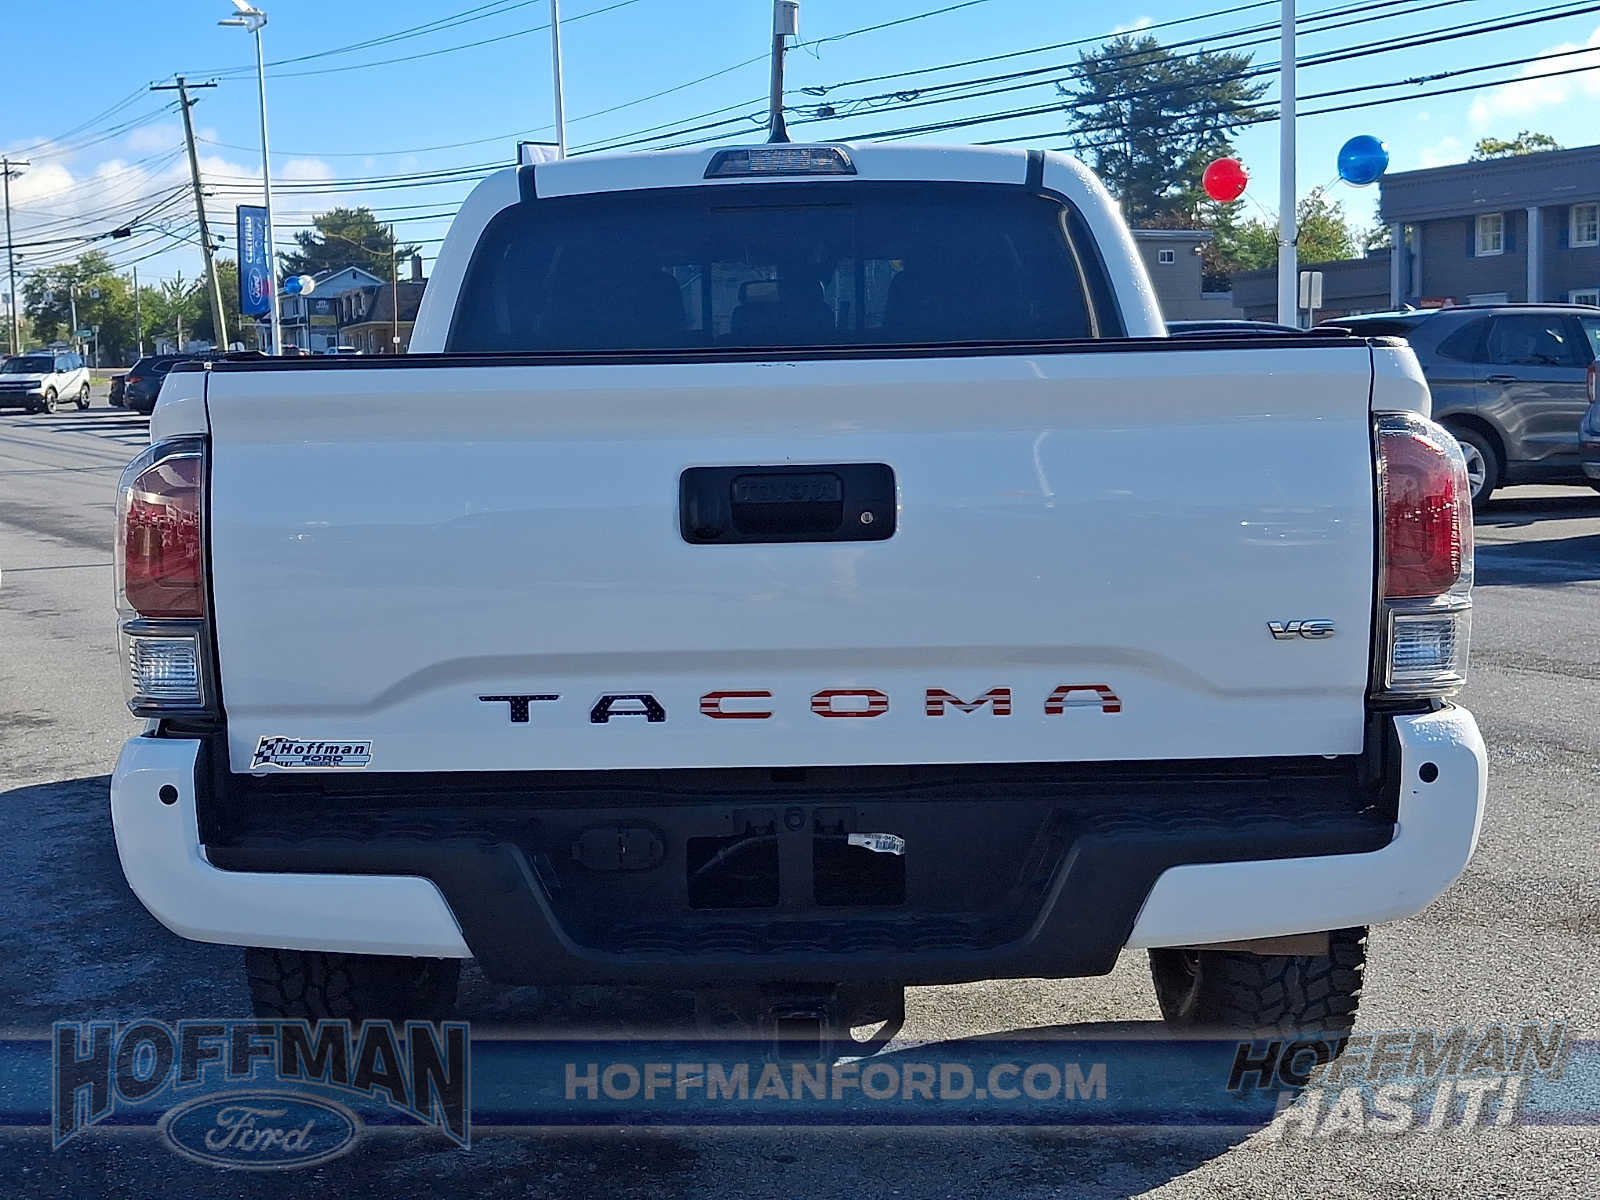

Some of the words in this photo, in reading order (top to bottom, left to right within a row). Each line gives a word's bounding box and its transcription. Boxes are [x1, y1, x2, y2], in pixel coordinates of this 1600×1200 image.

[244, 216, 253, 264] CERTIFIED
[1267, 619, 1336, 640] V6
[479, 685, 1122, 724] TACOMA
[280, 742, 366, 755] Hoffman
